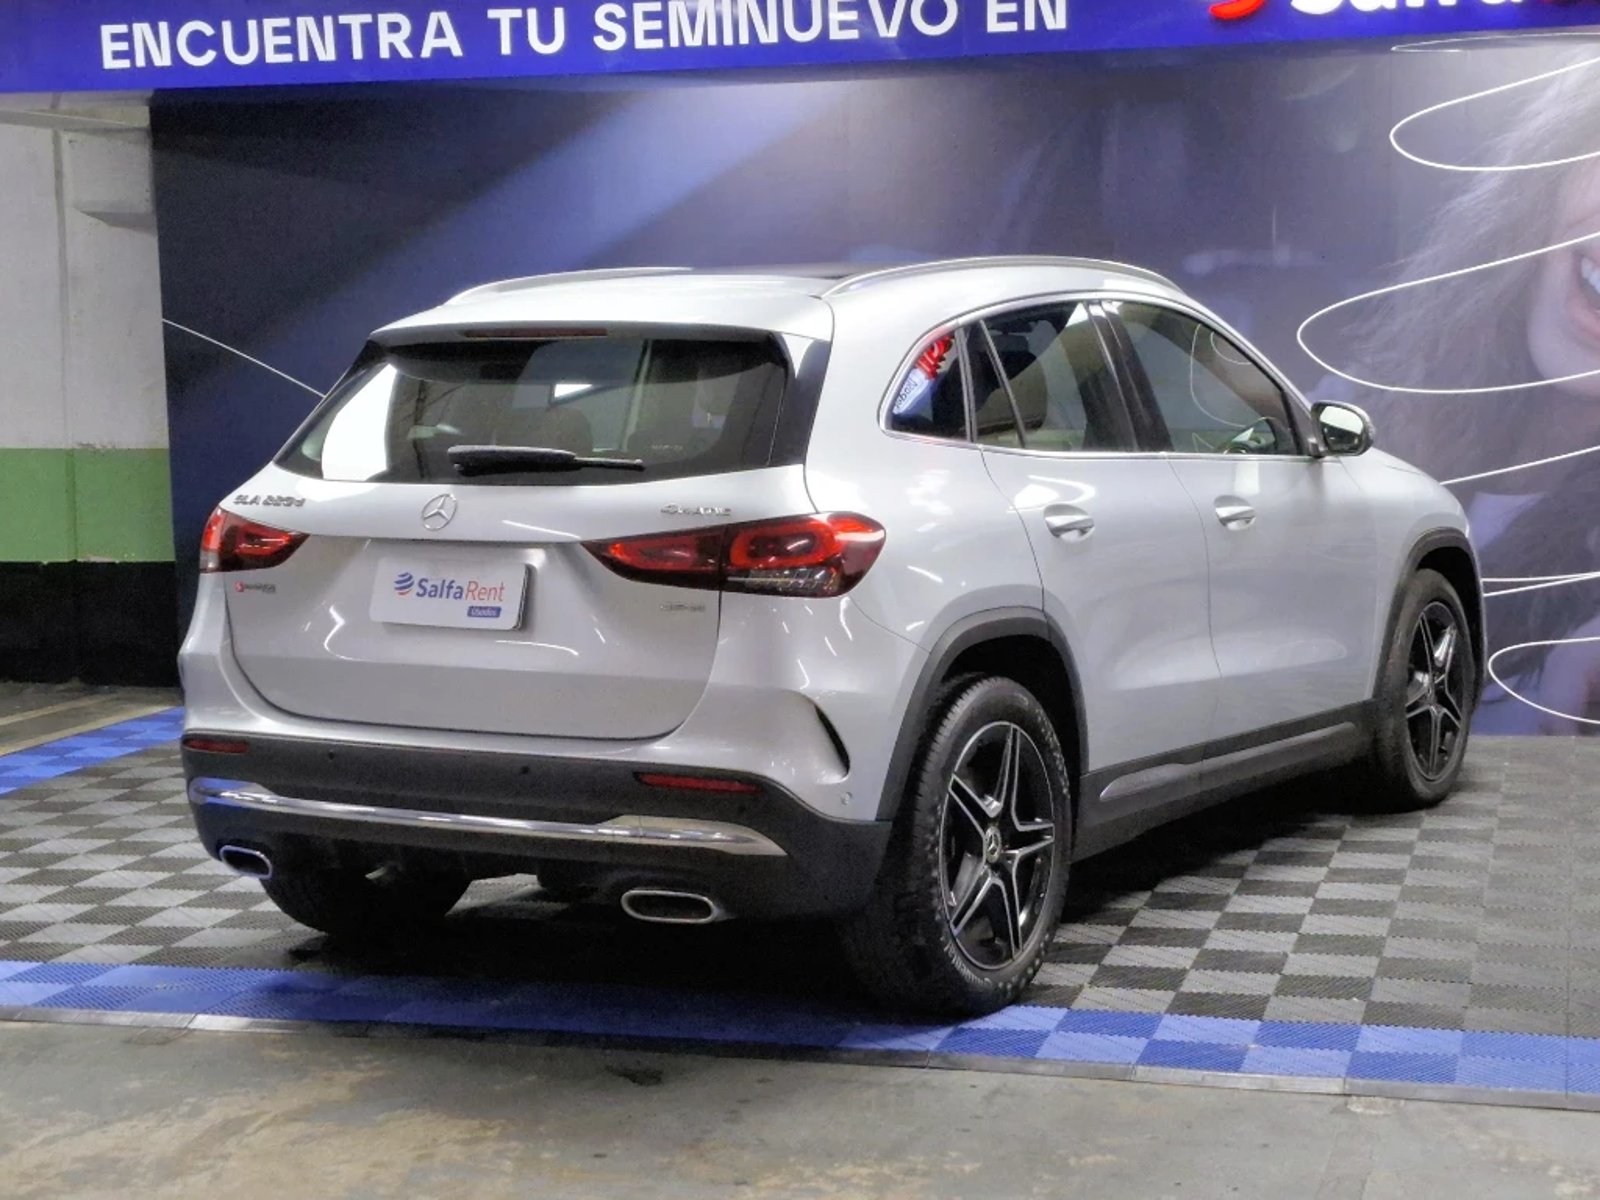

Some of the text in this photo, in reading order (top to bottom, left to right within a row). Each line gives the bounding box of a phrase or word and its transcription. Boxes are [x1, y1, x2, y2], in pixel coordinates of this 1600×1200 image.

[100, 0, 1067, 70] ENCUENTRA TU SEMINUEVO EN
